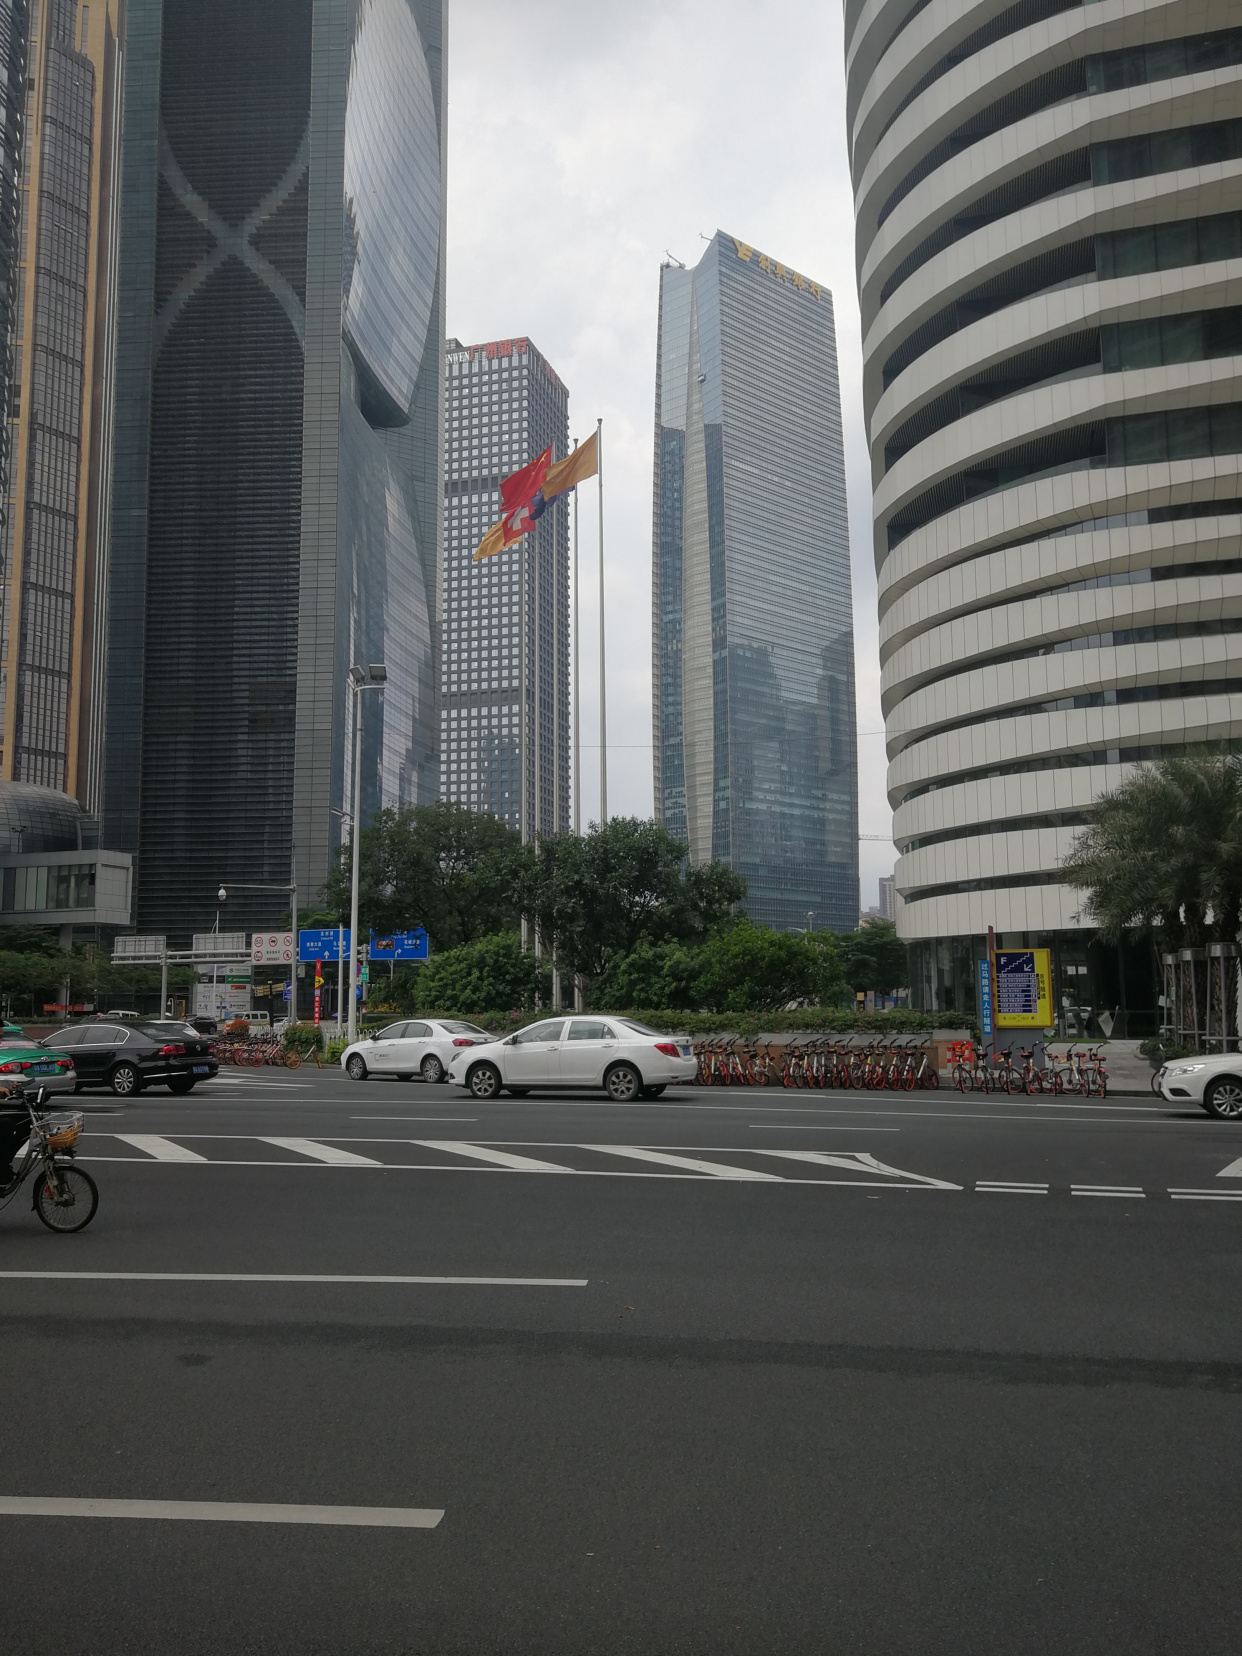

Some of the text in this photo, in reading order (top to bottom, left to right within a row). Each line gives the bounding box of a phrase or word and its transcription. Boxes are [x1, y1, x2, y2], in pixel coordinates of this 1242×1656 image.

[981, 963, 991, 1032] 过马路请走人行隧道
